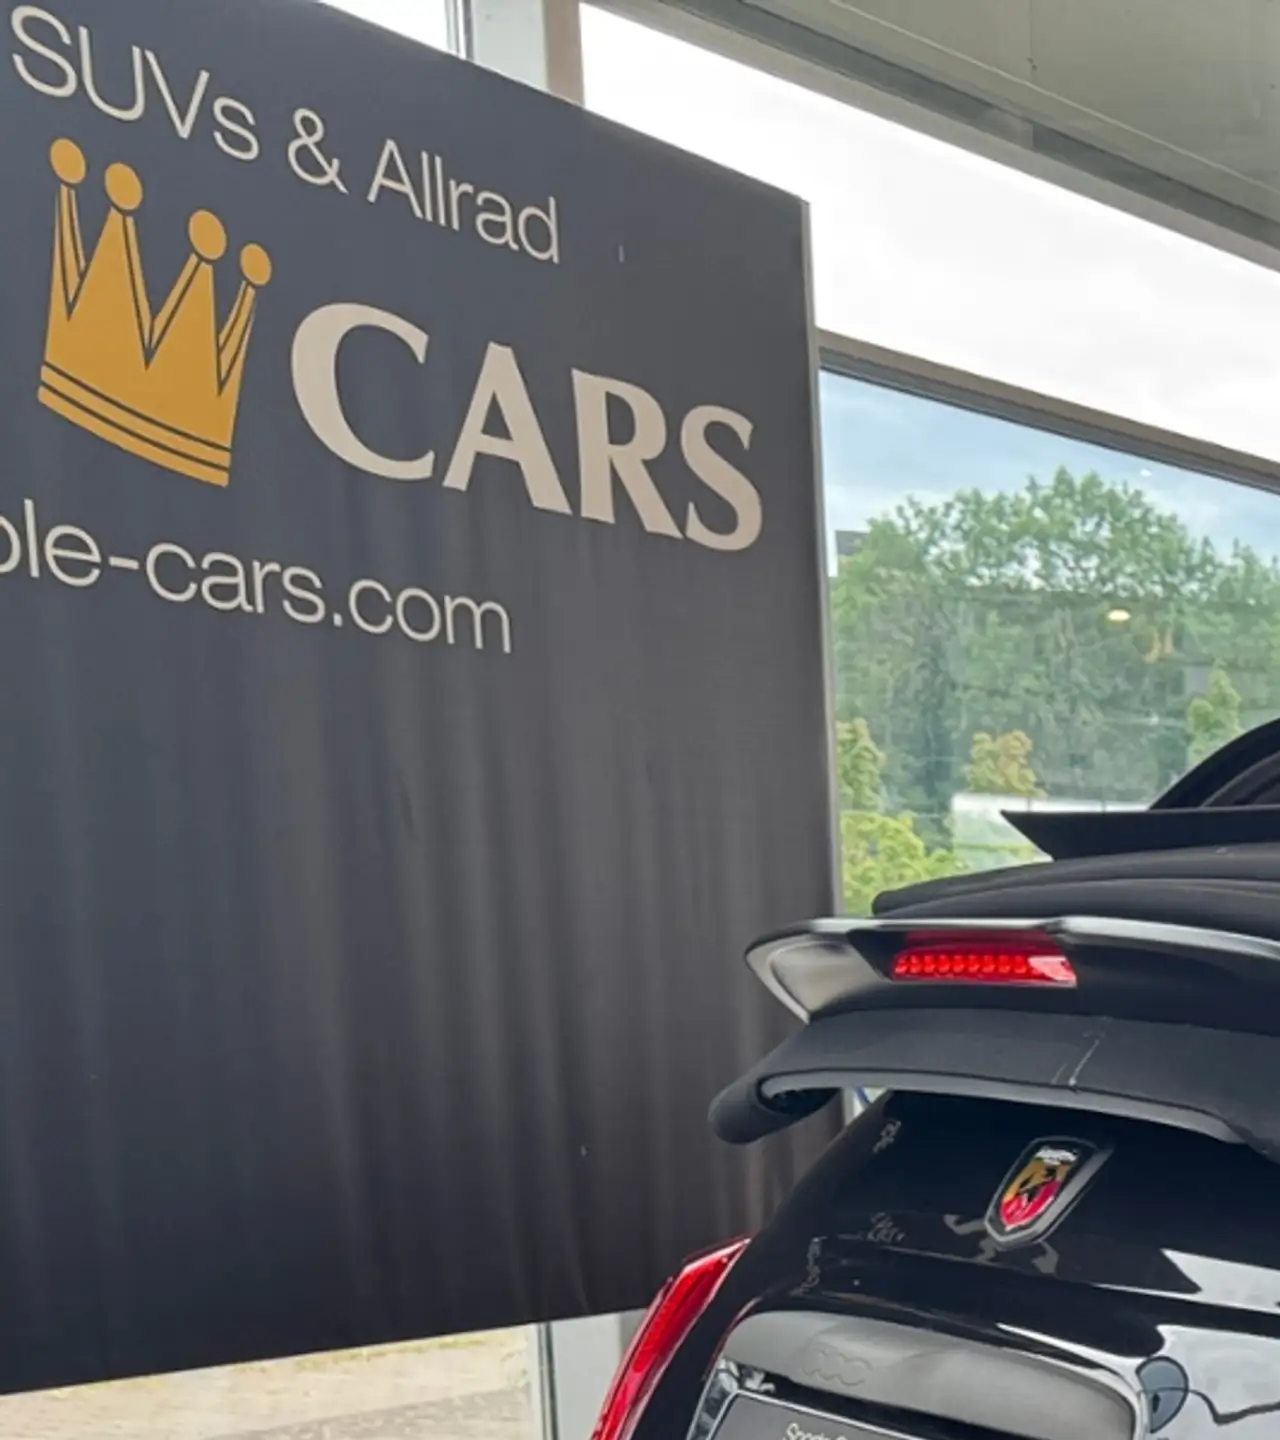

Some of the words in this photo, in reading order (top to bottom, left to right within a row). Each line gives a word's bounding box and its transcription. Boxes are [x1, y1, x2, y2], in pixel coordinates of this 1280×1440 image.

[11, 5, 260, 161] SUVs
[287, 108, 349, 194] &
[367, 138, 560, 264] Allrad
[291, 302, 763, 552] CARS
